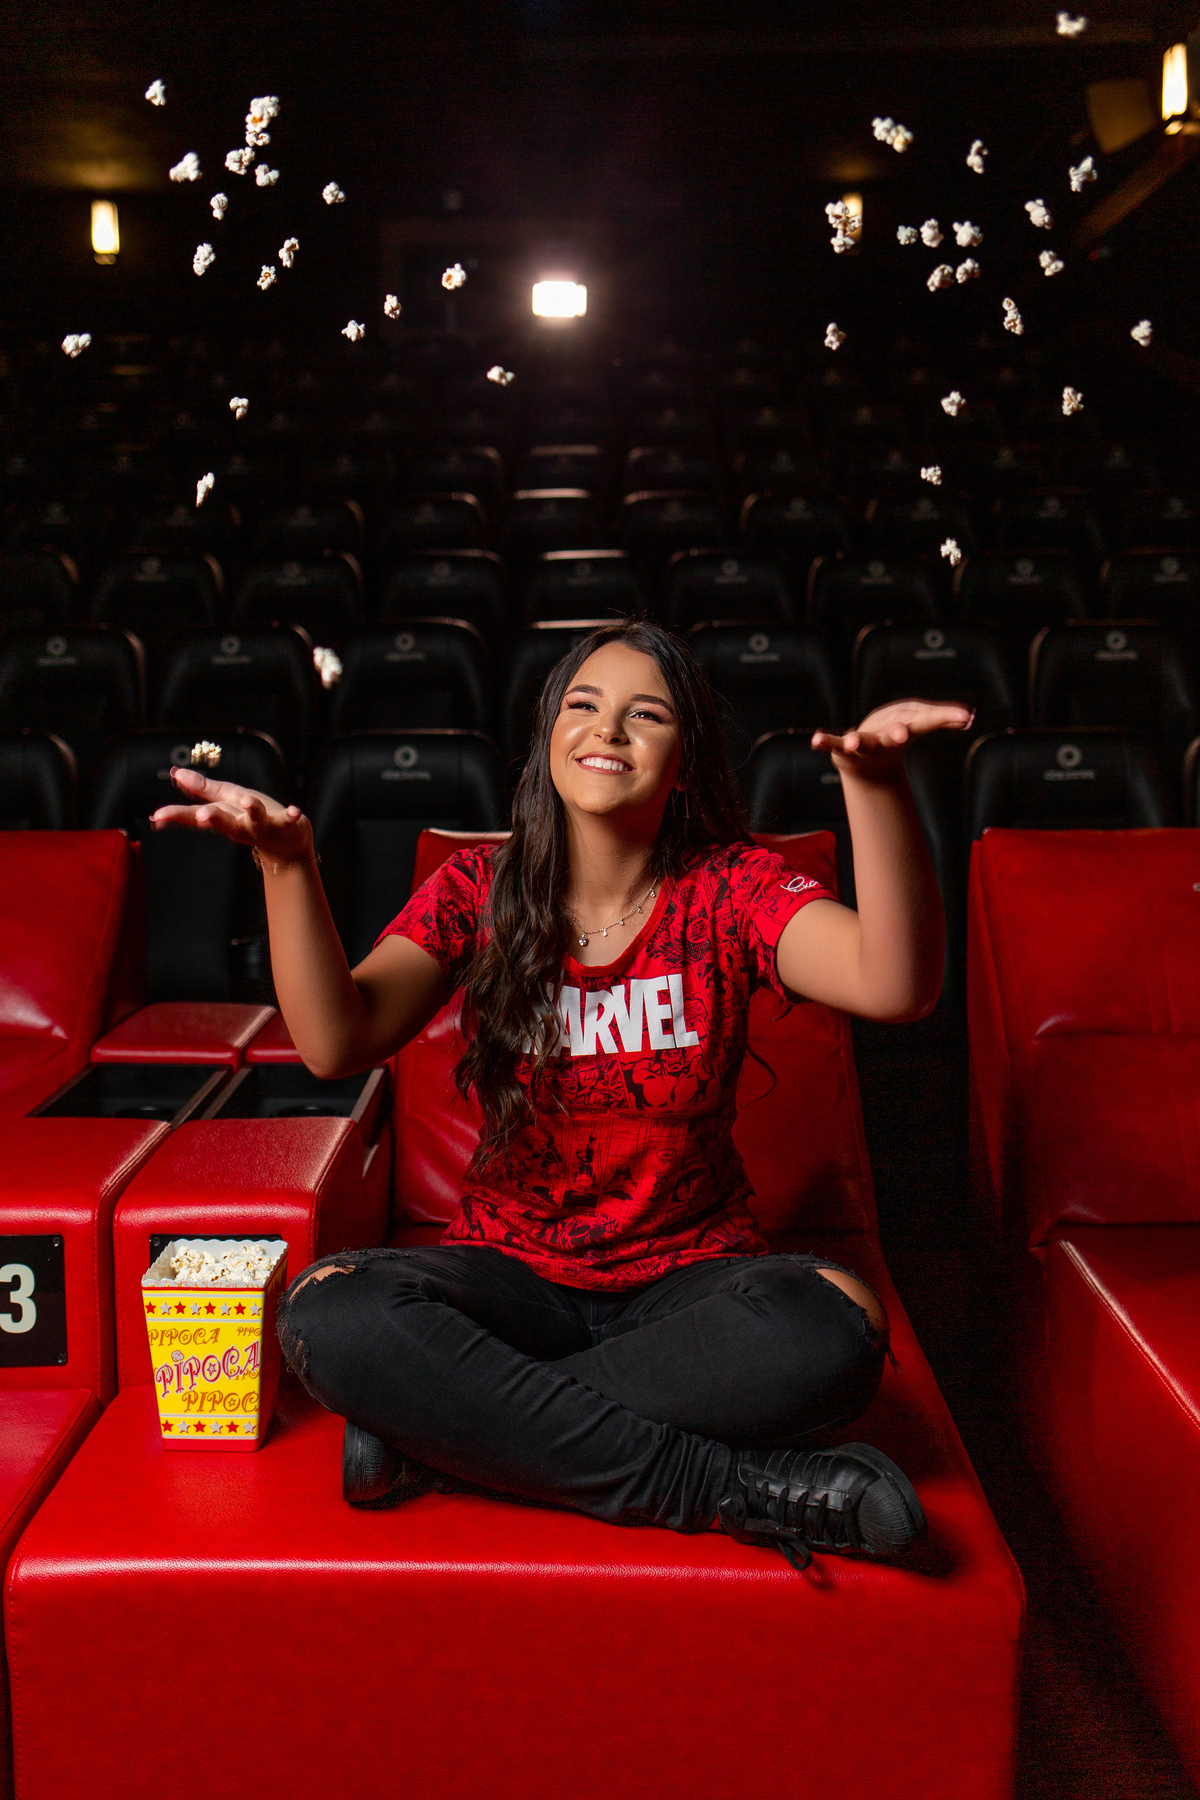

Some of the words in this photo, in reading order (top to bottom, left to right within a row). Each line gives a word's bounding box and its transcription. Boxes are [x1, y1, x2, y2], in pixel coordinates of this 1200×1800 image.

[521, 973, 700, 1057] ARVEL
[0, 1262, 38, 1334] 3
[147, 1327, 222, 1347] PIPOCA
[155, 1340, 262, 1399] PIPOCA
[181, 1389, 260, 1414] PIPOC
